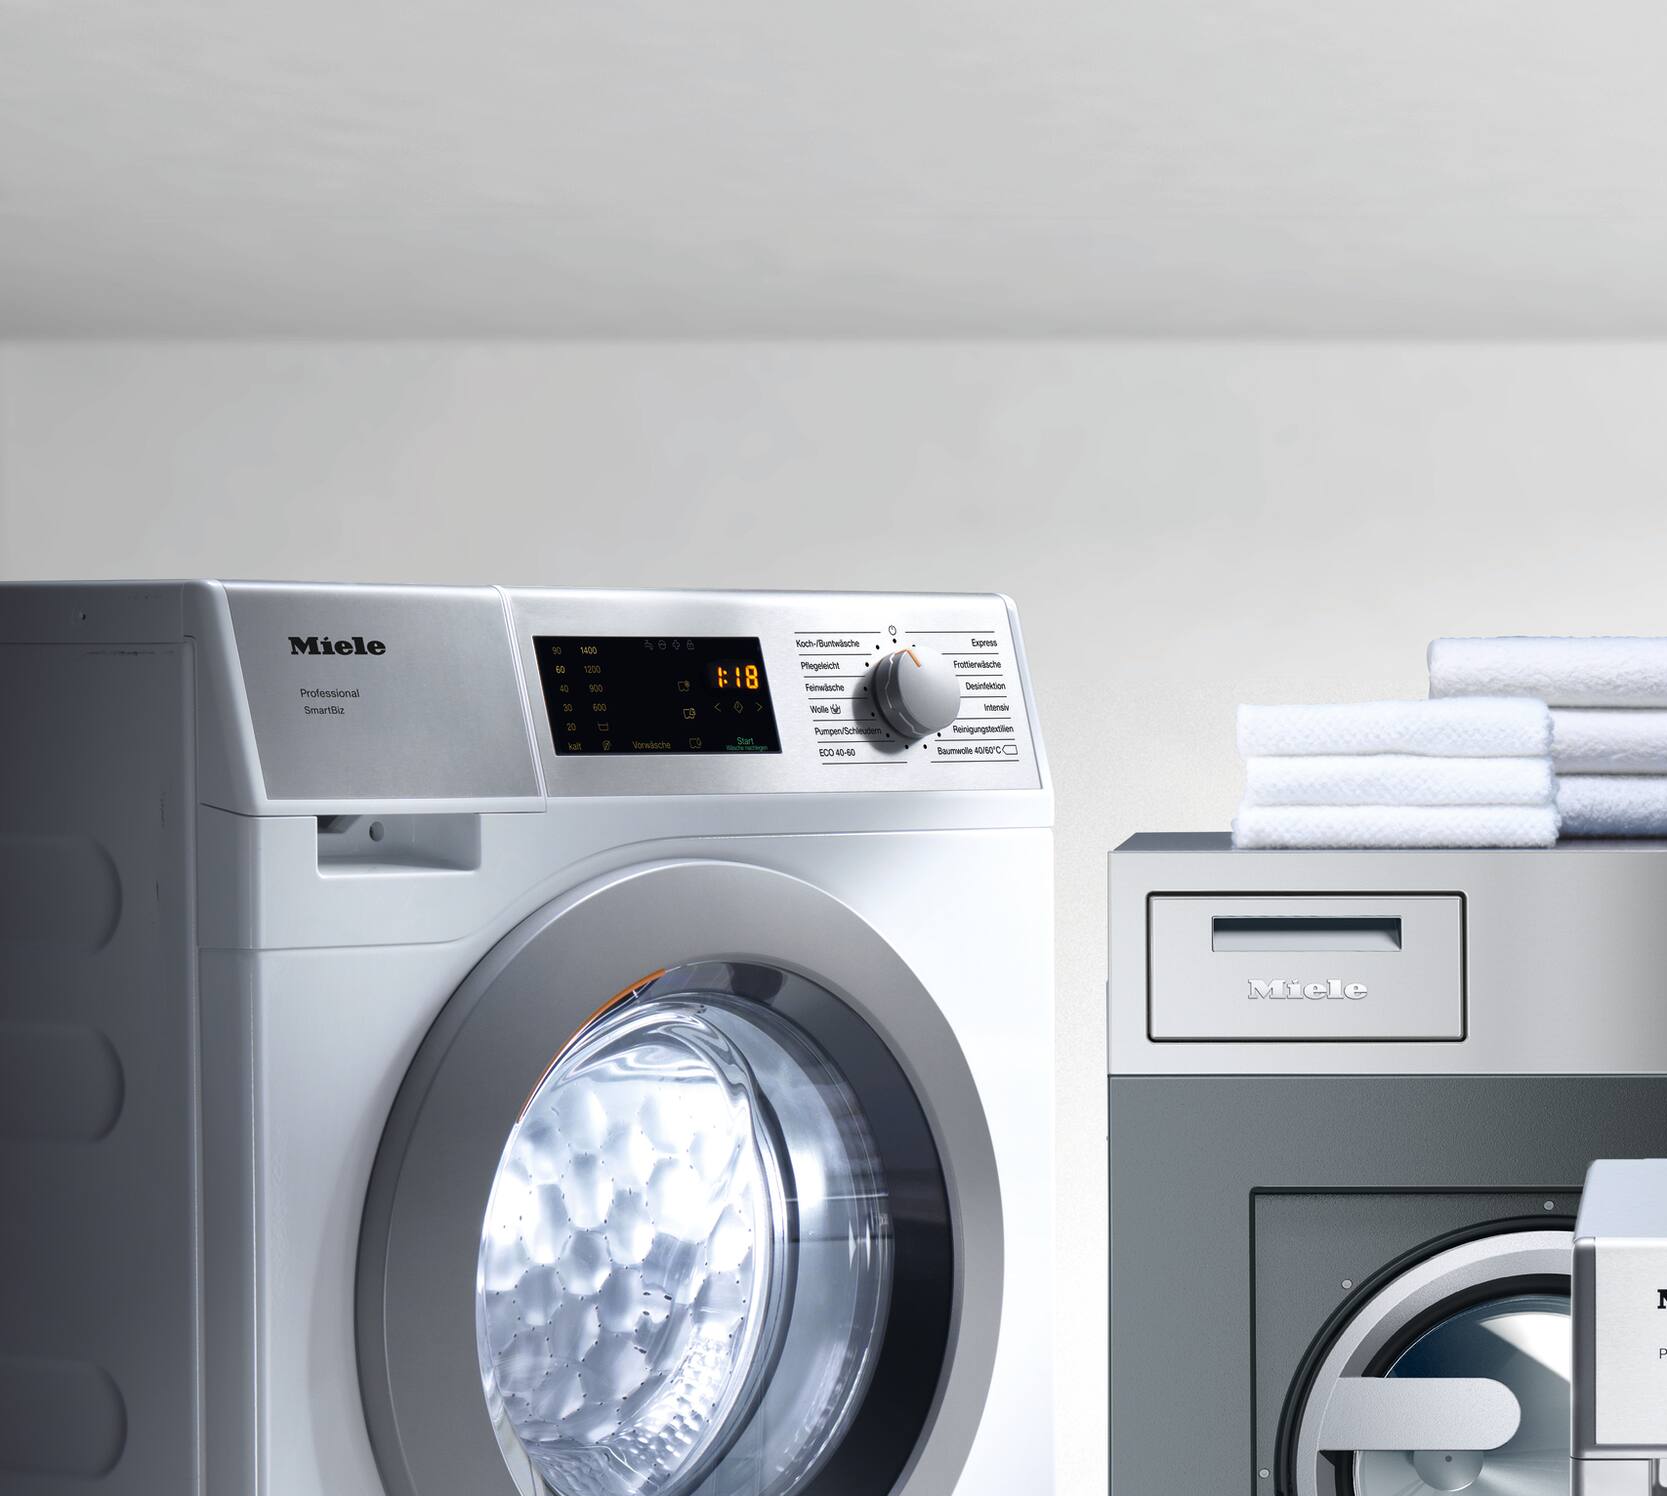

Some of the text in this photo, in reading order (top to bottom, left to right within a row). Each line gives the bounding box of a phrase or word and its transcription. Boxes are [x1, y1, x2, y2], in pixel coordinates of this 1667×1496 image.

[288, 637, 386, 655] Miele
[796, 640, 860, 648] Koch-/Buntwäsche
[971, 639, 997, 648] Express
[552, 647, 561, 655] 90
[580, 647, 597, 655] 1400
[801, 662, 840, 671] Pflegeleicht
[953, 661, 1001, 669] Frottierwäsche
[556, 666, 565, 674] 60
[584, 666, 600, 674] 1200
[718, 665, 758, 689] 1:18
[560, 685, 568, 693] 40
[589, 684, 603, 693] 900
[805, 684, 844, 692] Feinwäsche
[966, 682, 1006, 690] Desinfektion
[300, 689, 360, 698] Professional
[304, 706, 345, 715] SmartBiz
[563, 704, 572, 712] 30
[593, 704, 607, 712] 600
[810, 706, 829, 714] Wolle
[984, 704, 1009, 712] Intensiv
[567, 723, 576, 731] 20
[953, 725, 1014, 735] Reinigungstextilien
[814, 727, 882, 737] Pumpen/Schleudern
[737, 737, 754, 745] Start
[632, 741, 671, 750] Vorwäsche
[819, 749, 855, 757] ECO 40-60
[937, 746, 1001, 755] Baumwolle 40/60°C
[1247, 979, 1368, 1000] Miele
